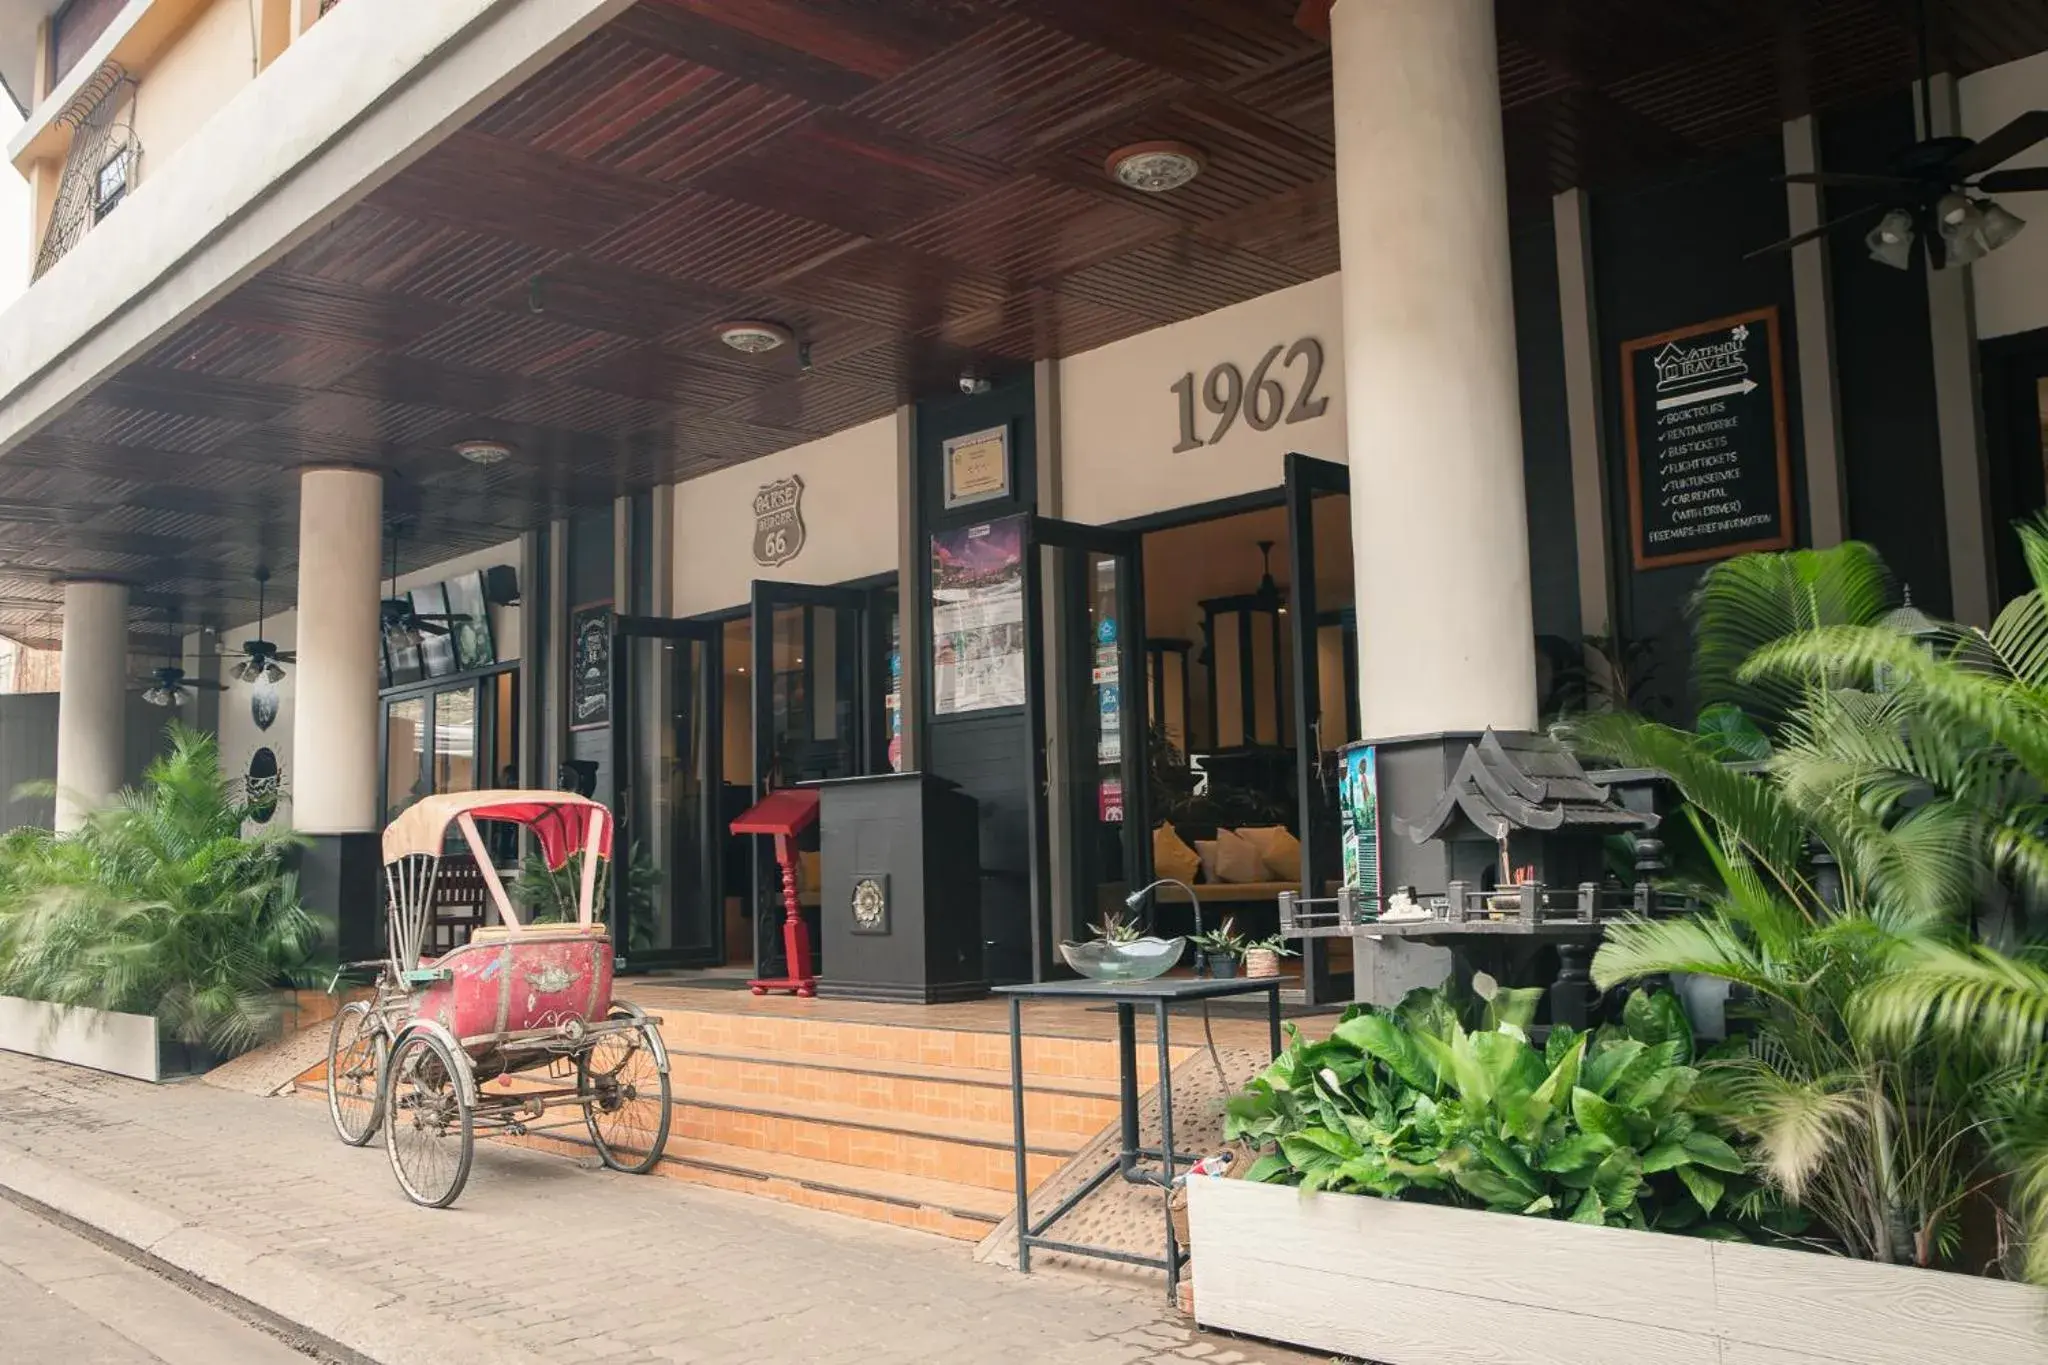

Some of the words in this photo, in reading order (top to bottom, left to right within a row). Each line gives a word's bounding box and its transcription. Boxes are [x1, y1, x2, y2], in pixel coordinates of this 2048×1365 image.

[1680, 353, 1743, 375] TRAVELS
[1169, 337, 1330, 454] 1962
[1666, 408, 1691, 424] BOOK
[765, 529, 786, 557] 66
